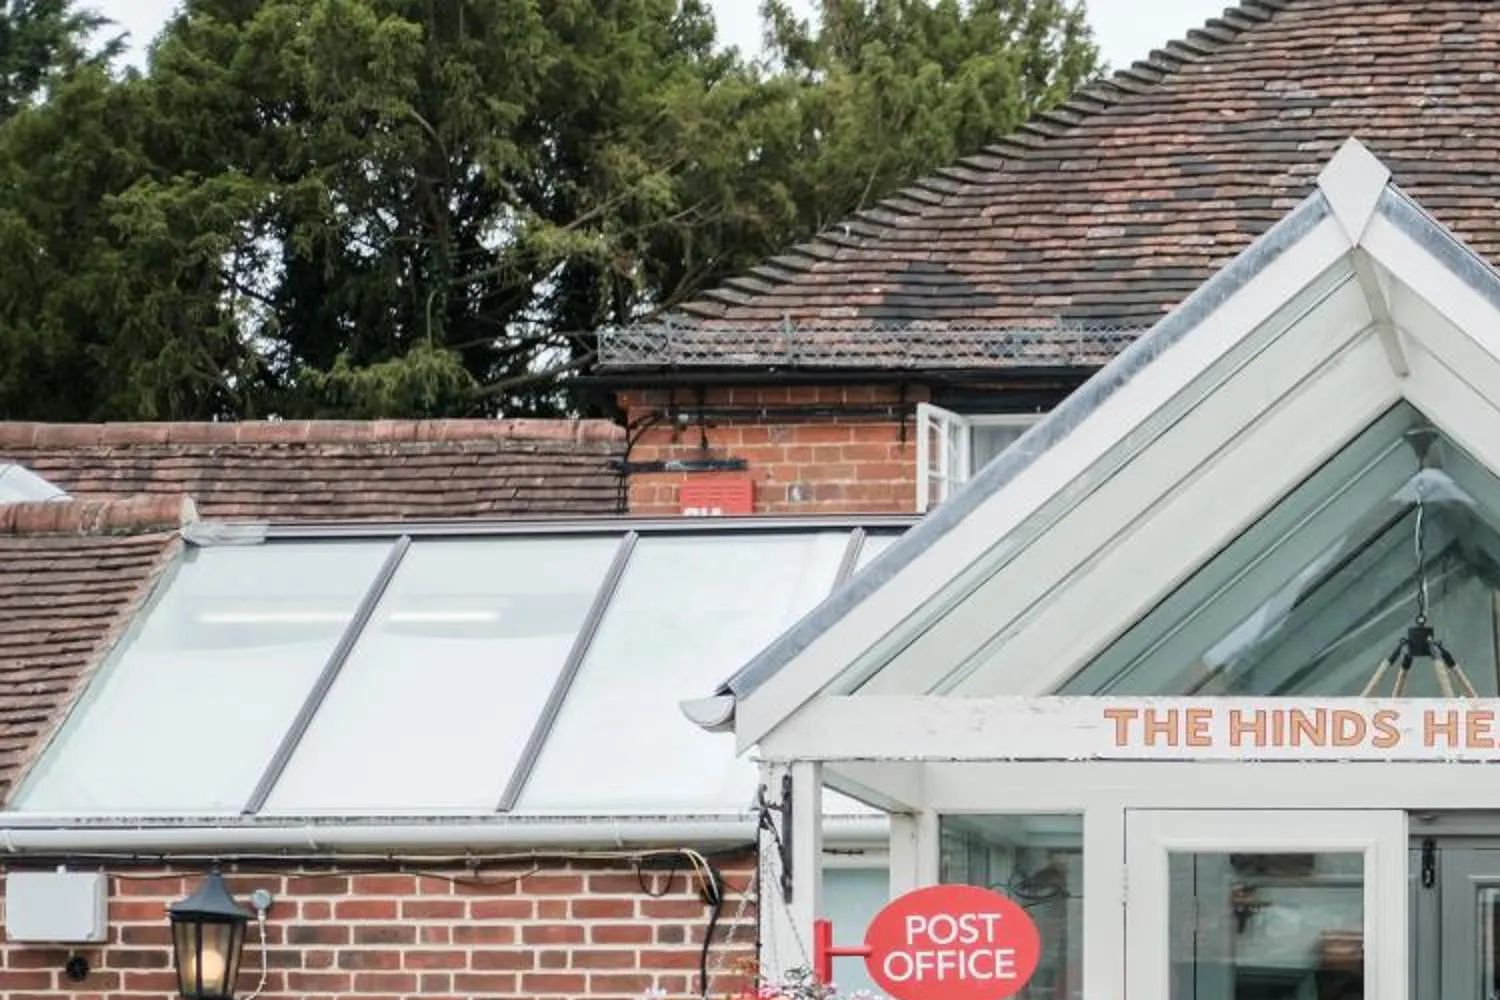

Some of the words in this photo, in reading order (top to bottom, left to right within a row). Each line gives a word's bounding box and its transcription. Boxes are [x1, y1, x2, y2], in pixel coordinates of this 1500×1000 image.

[1104, 708, 1212, 747] THE
[1229, 707, 1400, 748] HINDS
[905, 913, 1001, 945] POST
[883, 949, 1016, 981] OFFICE
